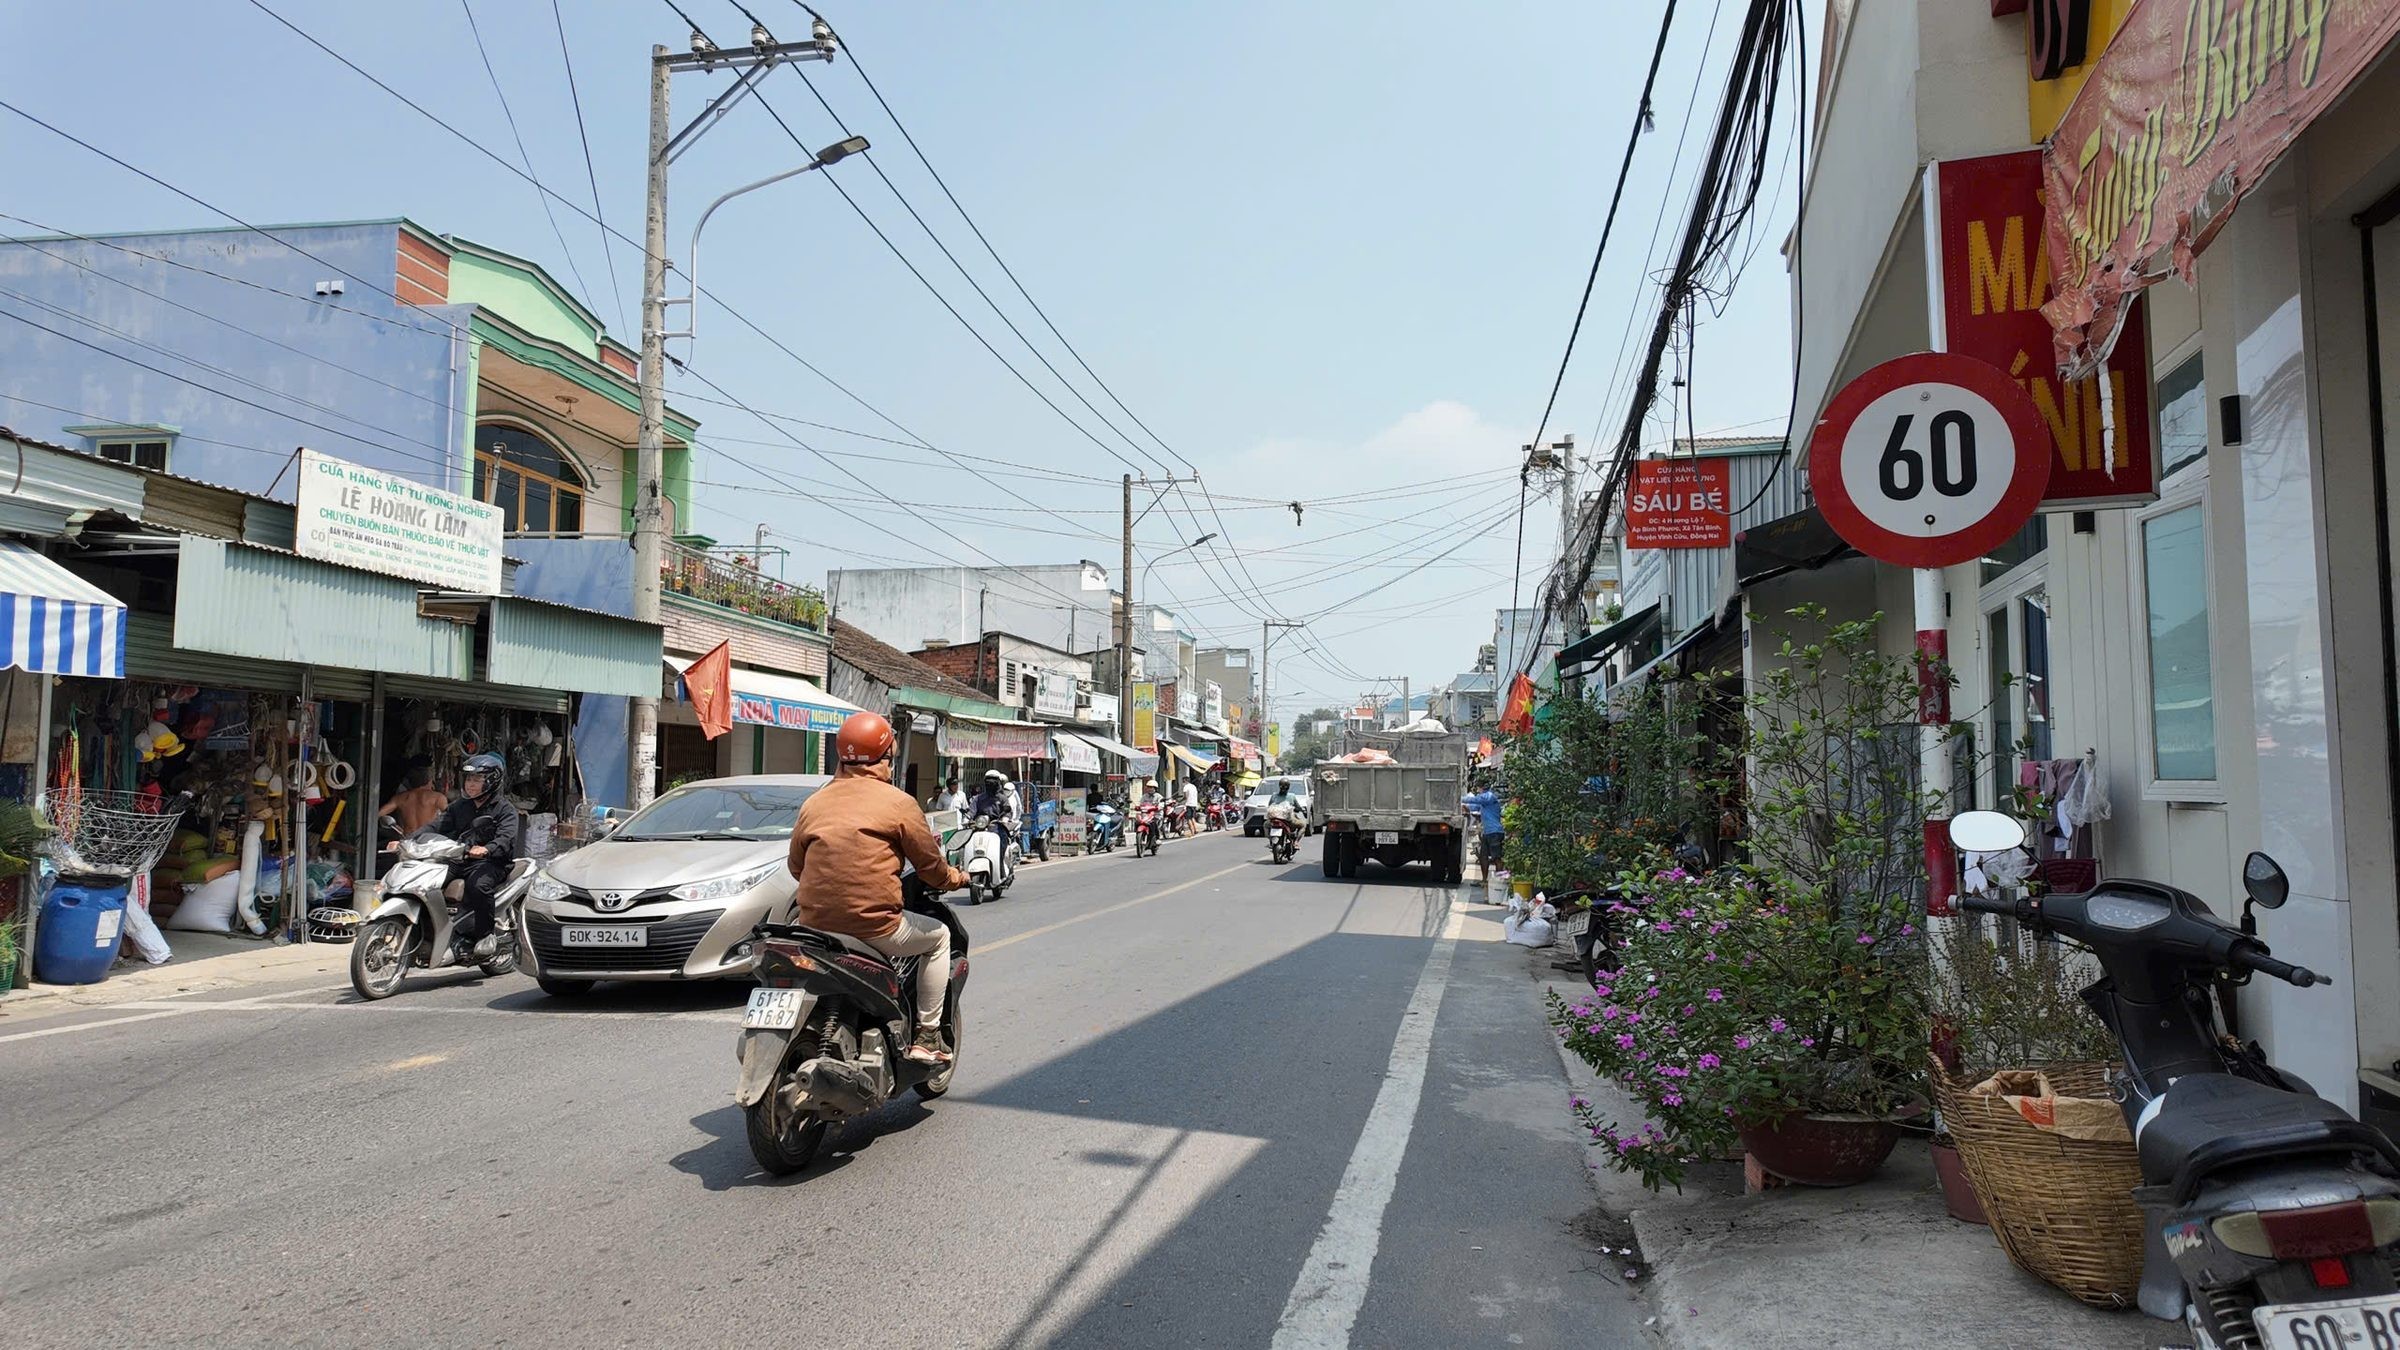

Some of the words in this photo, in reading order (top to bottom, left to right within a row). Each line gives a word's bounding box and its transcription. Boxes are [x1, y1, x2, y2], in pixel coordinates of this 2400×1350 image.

[1879, 409, 1978, 501] 60
[341, 486, 362, 511] LÊ
[370, 494, 427, 528] HOÀNG
[434, 511, 467, 538] LÂM
[1632, 489, 1681, 513] SÁU
[1690, 487, 1723, 511] BÉ
[779, 705, 811, 727] MAY
[569, 930, 639, 943] 60K-924.14
[757, 991, 795, 1008] 61-E1
